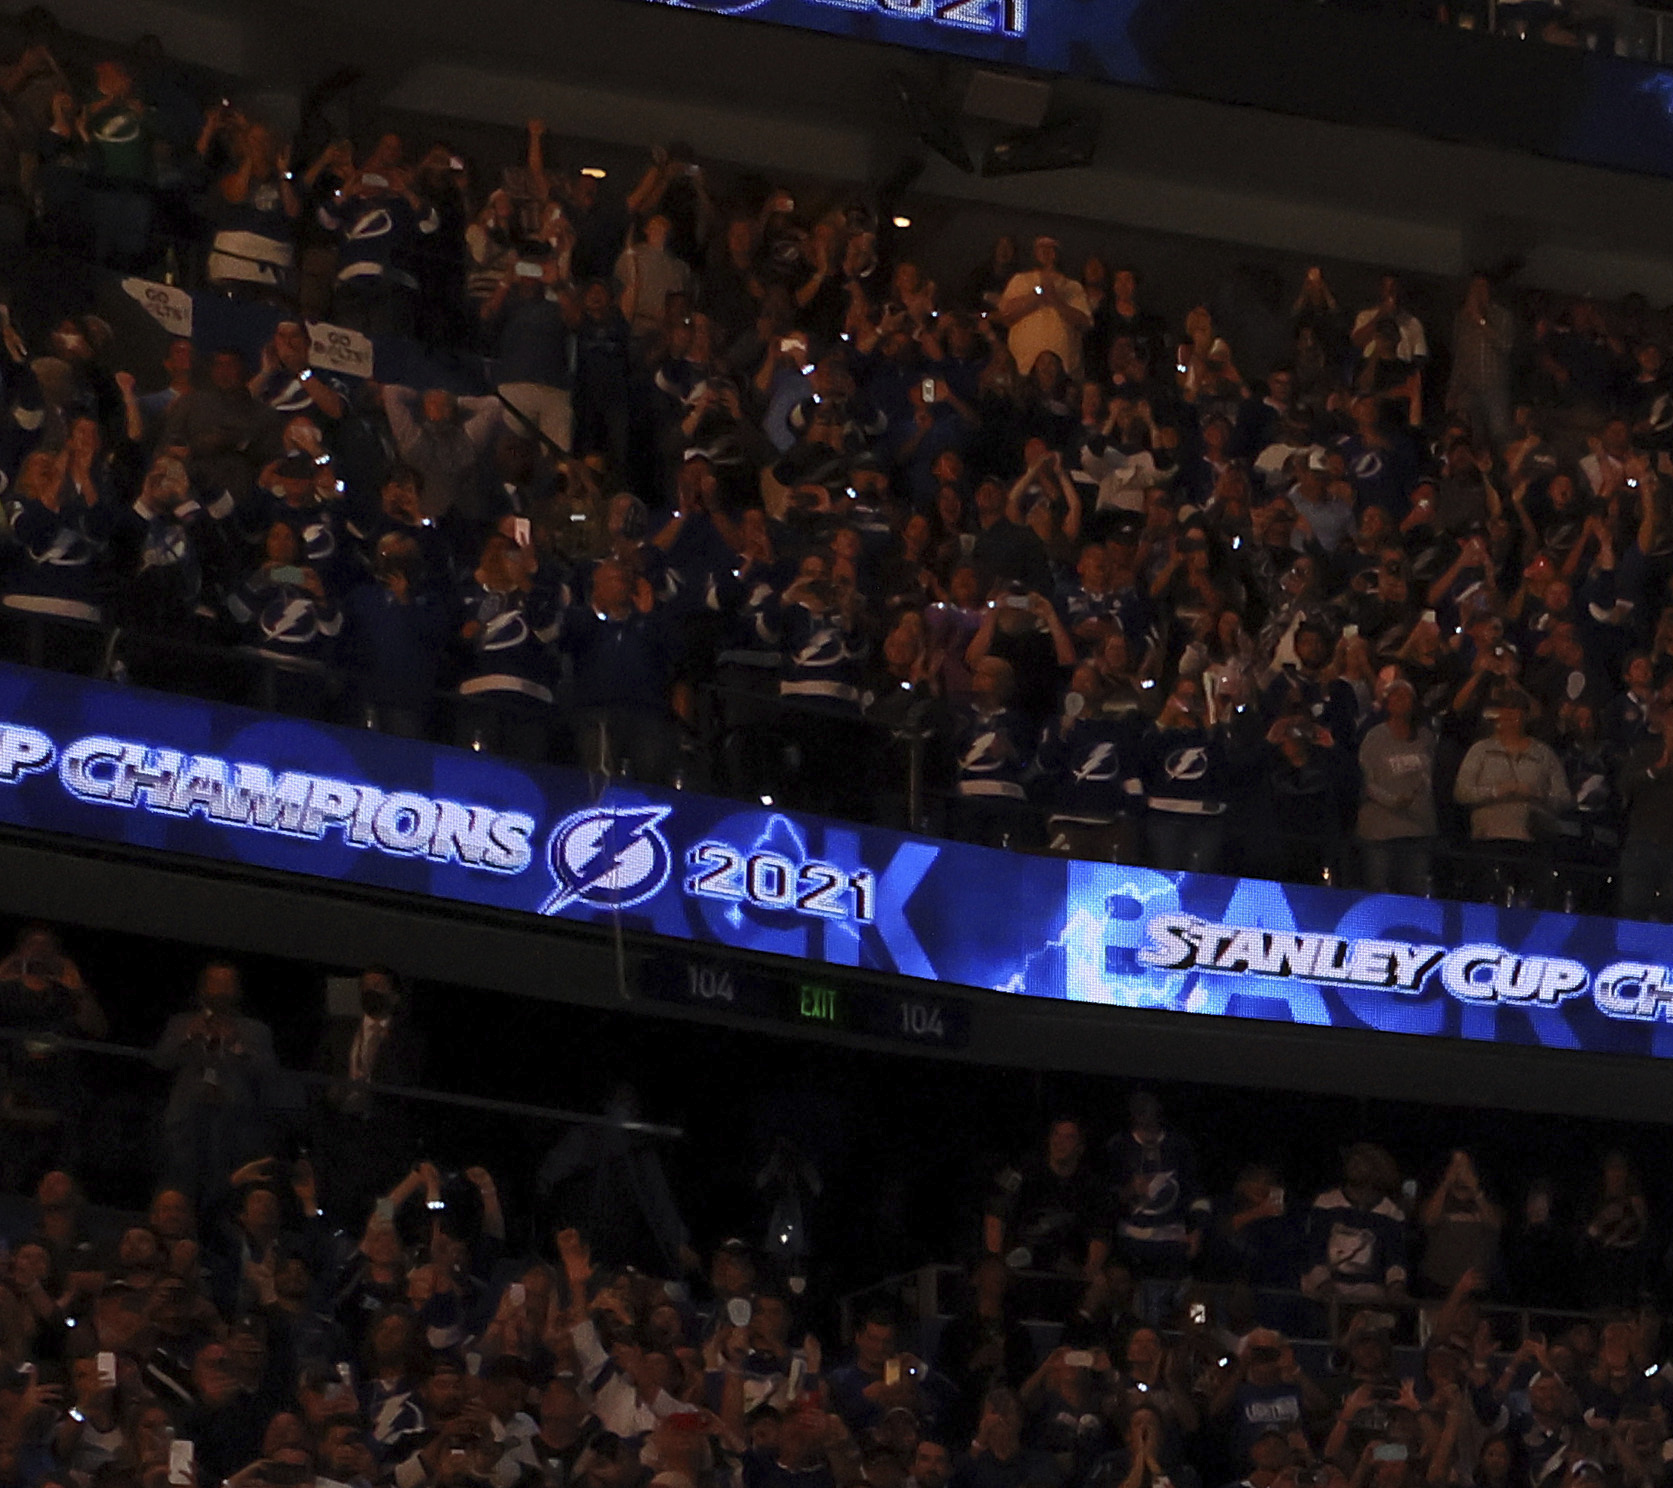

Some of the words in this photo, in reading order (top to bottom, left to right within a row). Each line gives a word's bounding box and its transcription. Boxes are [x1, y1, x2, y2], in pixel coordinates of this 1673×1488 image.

[58, 734, 535, 875] CHAMPIONS
[684, 841, 876, 924] 2021
[1139, 912, 1445, 994] STANLEY
[1439, 943, 1591, 1008] CUP
[687, 964, 735, 1002] 104
[799, 985, 838, 1022] EXIT
[899, 1002, 945, 1038] 104
